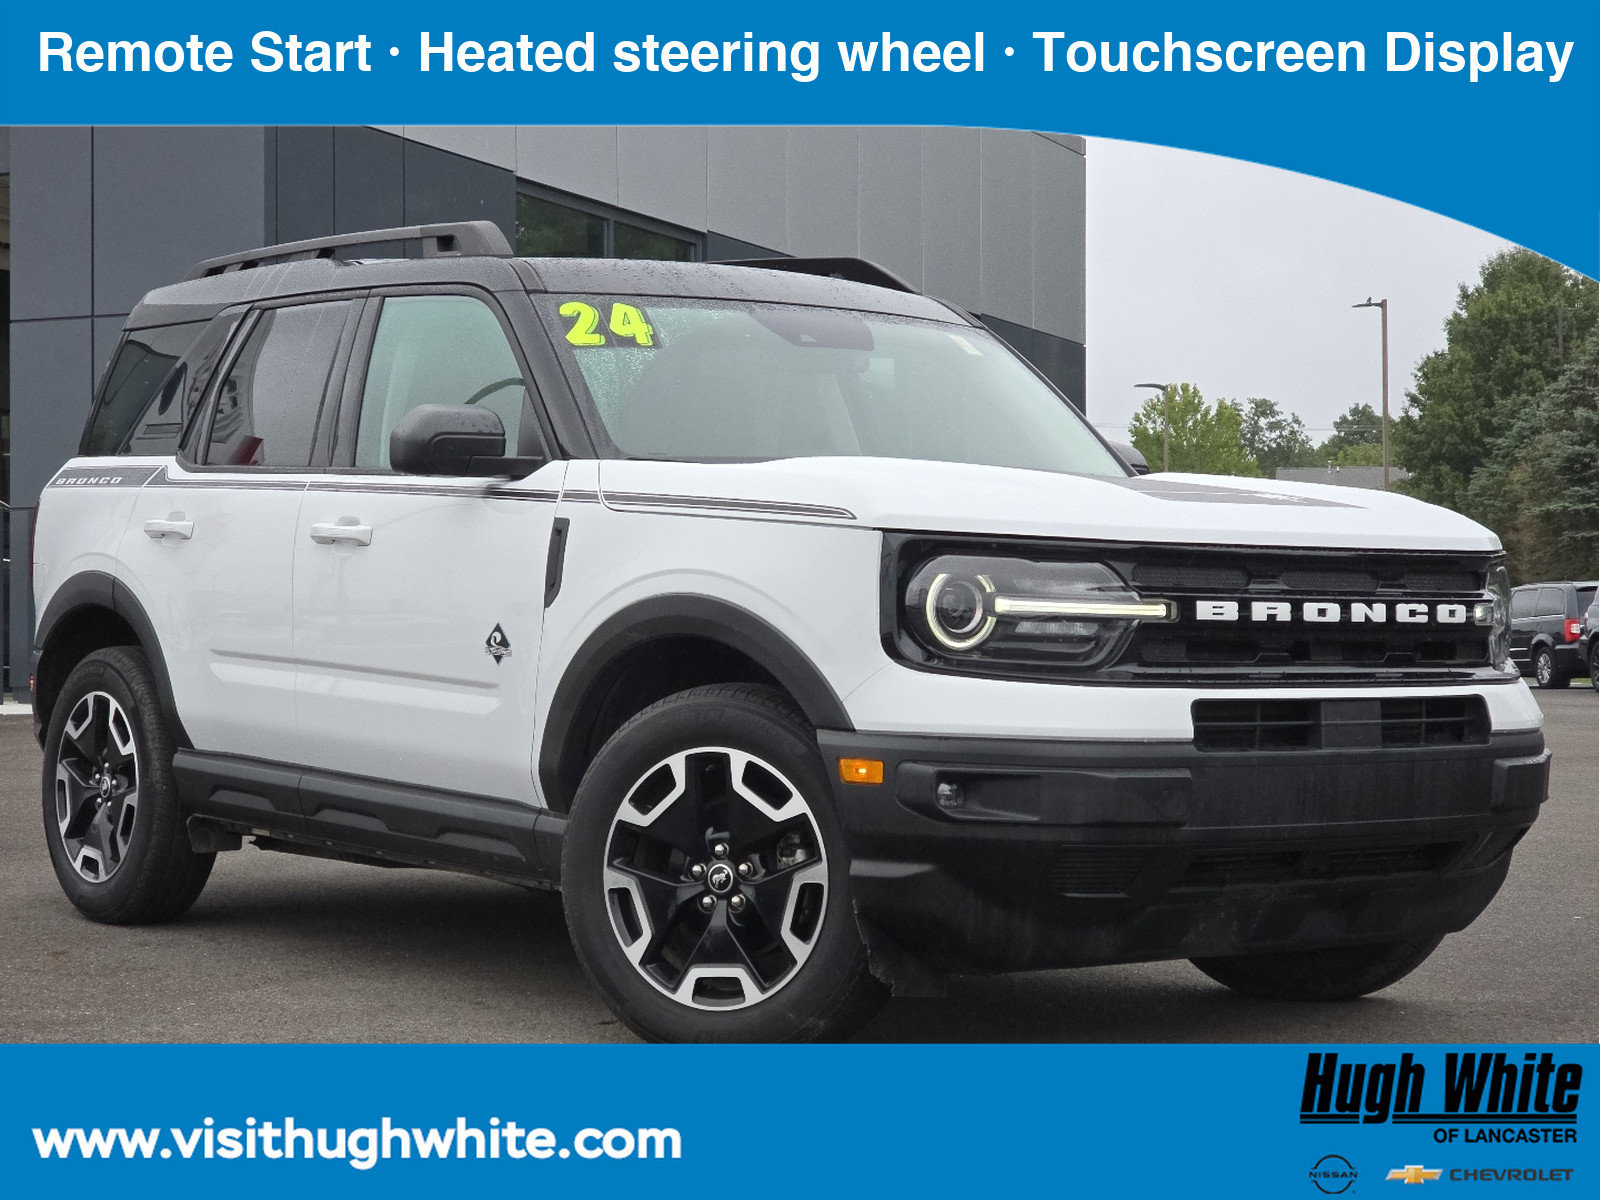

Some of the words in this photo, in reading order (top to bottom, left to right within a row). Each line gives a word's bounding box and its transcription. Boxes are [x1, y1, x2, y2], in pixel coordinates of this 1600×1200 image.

[558, 301, 654, 347] 24
[55, 476, 123, 485] BRONCO
[1195, 600, 1467, 624] BRONCO
